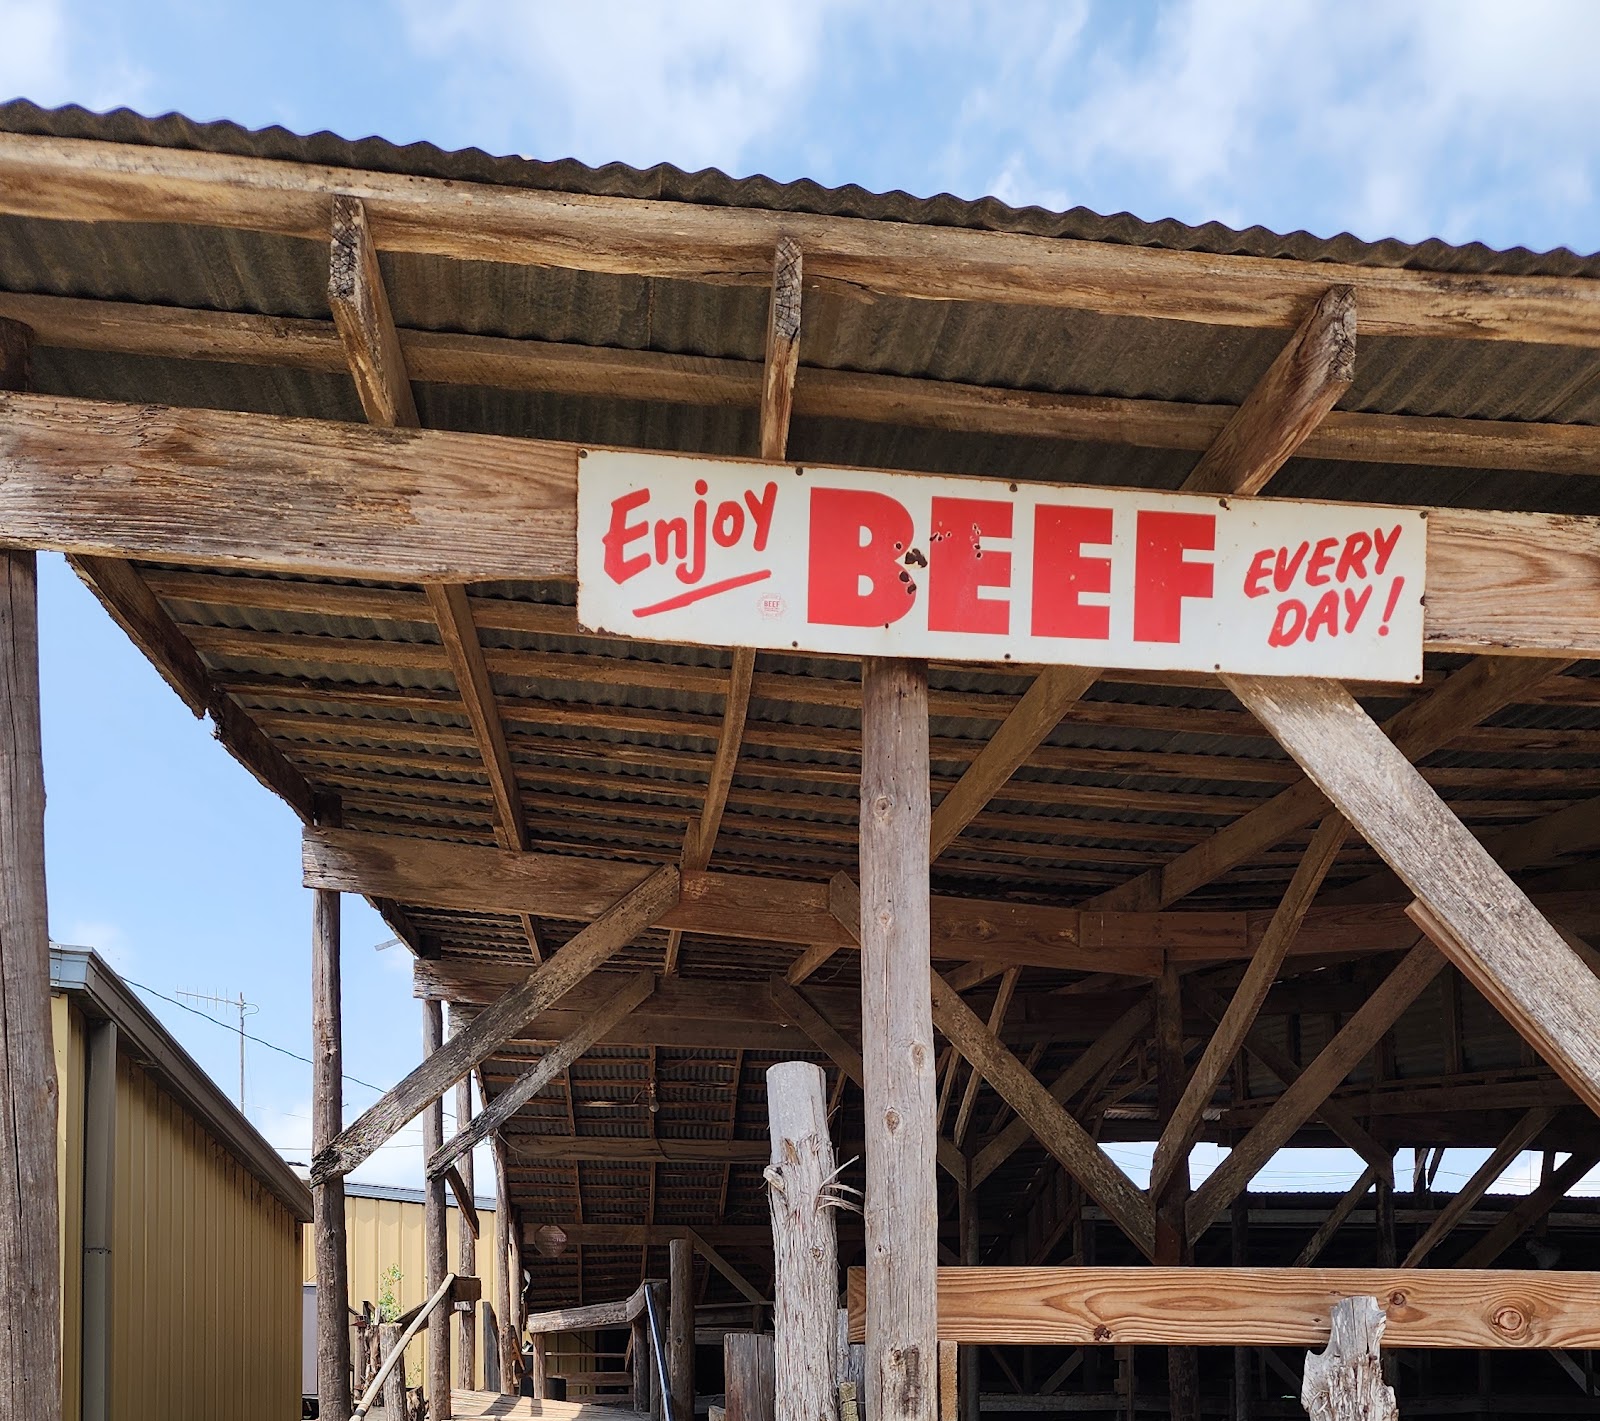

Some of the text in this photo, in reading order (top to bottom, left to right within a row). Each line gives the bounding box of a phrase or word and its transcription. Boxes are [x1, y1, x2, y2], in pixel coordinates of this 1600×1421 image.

[602, 479, 779, 585] Enjoy
[807, 486, 1217, 644] BEEF
[1243, 524, 1403, 599] EVERY
